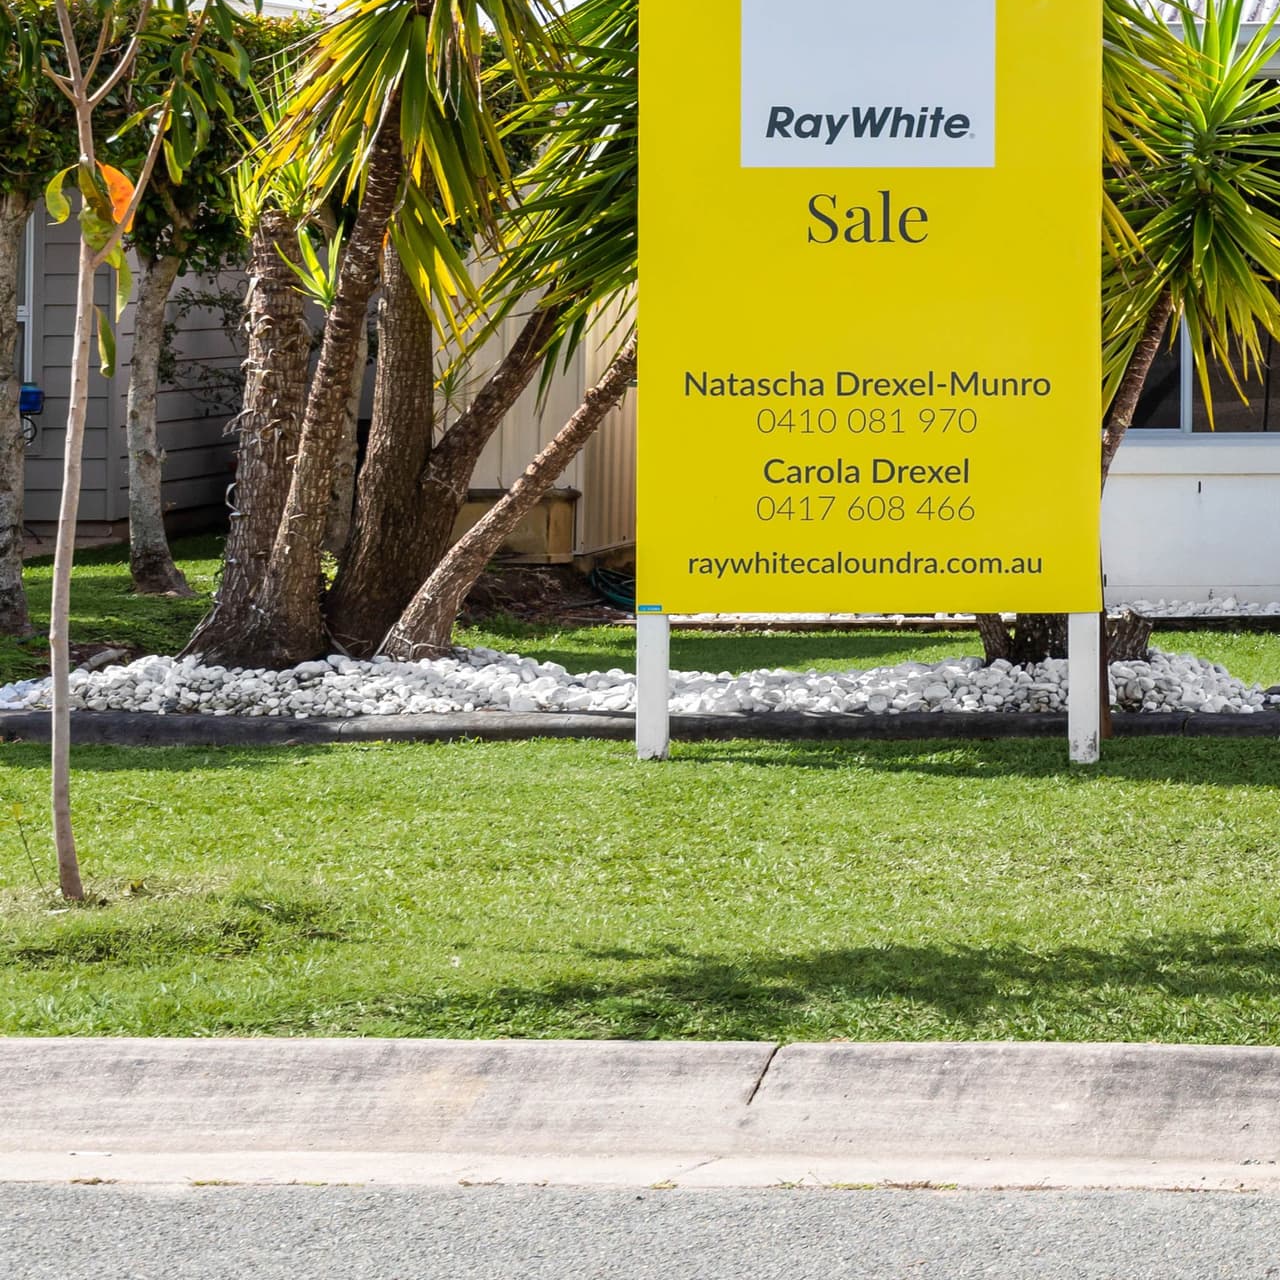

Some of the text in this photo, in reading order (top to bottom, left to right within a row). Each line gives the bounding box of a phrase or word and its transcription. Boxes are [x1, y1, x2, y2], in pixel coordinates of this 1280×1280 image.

[808, 190, 929, 243] Sale
[685, 371, 1051, 397] Natascha Drexel-Munro
[757, 408, 978, 433] 0410 081 970
[763, 458, 969, 484] Carola Drexel
[757, 496, 976, 521] 0417 608 466
[688, 552, 1042, 580] raywhitecaloundra.com.au
